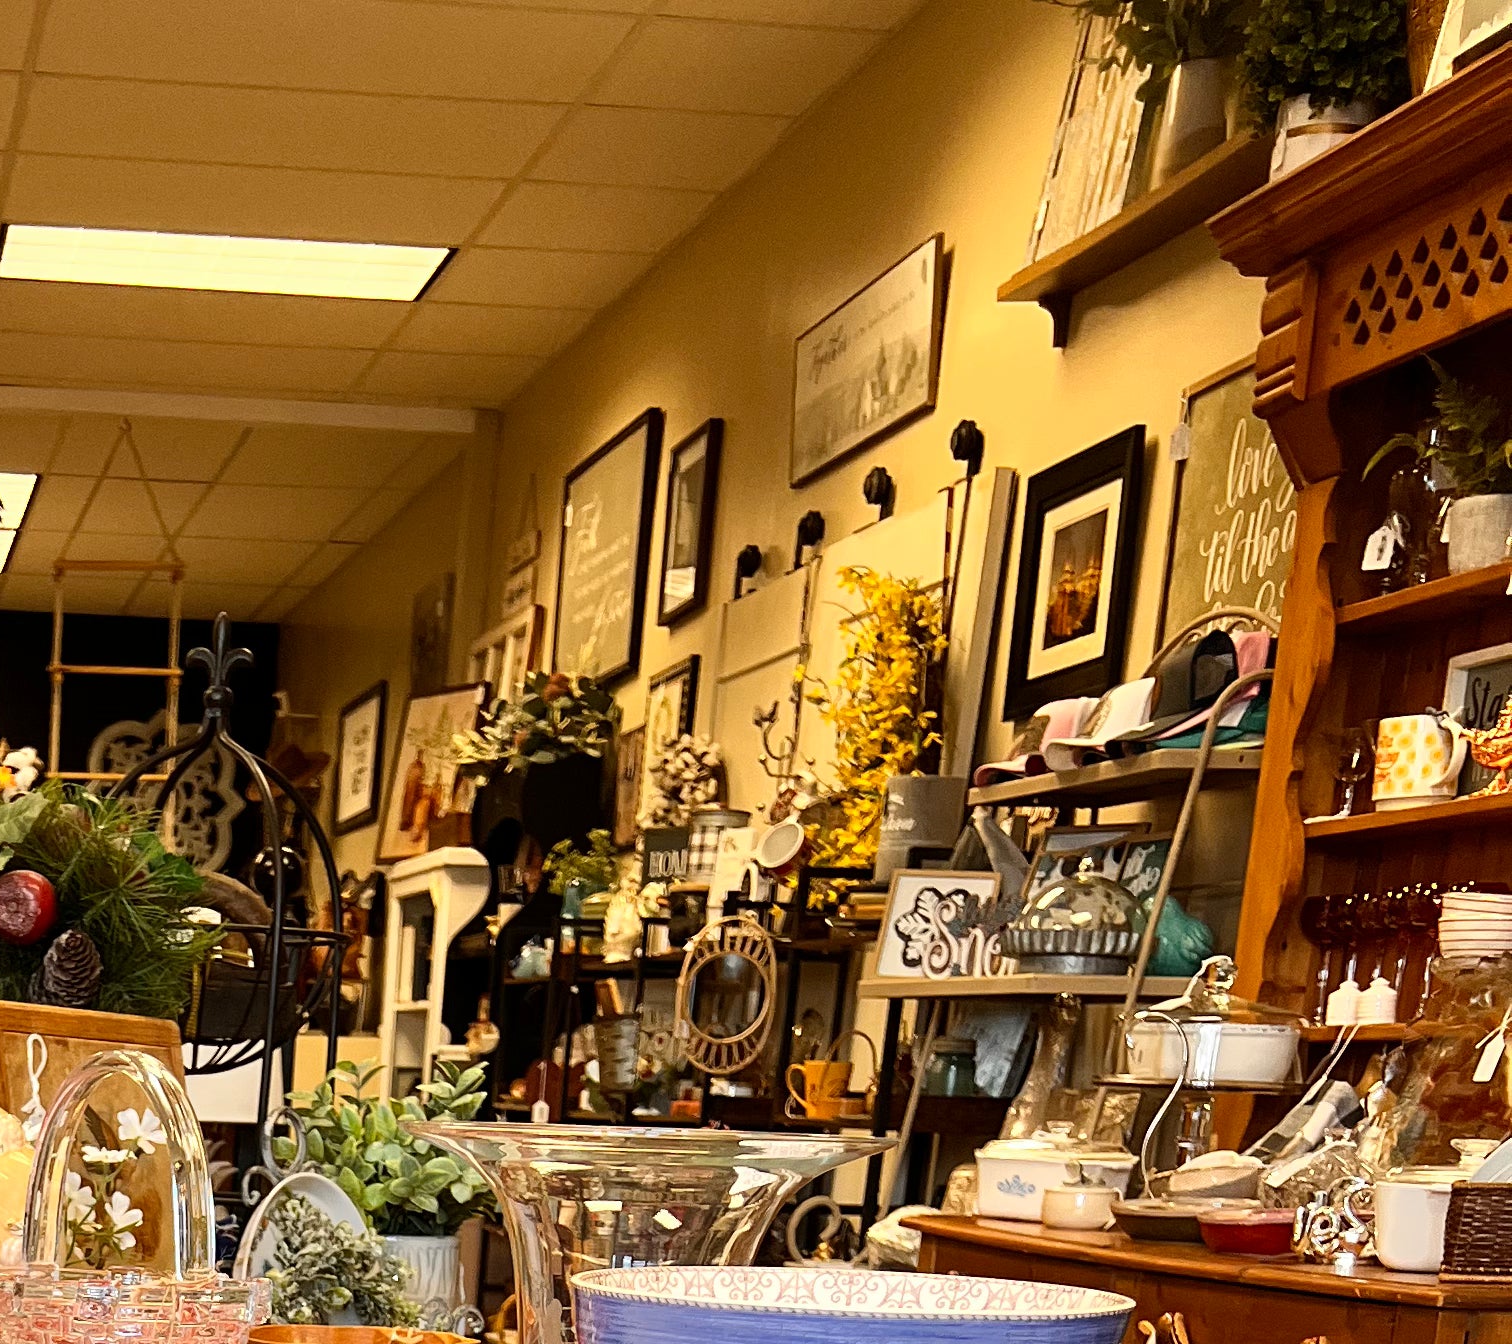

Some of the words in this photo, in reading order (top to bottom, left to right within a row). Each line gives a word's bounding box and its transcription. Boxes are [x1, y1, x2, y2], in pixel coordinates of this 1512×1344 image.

[1215, 418, 1279, 516] love
[1237, 497, 1280, 584] the
[1464, 676, 1512, 729] Sta
[648, 849, 688, 878] HOM
